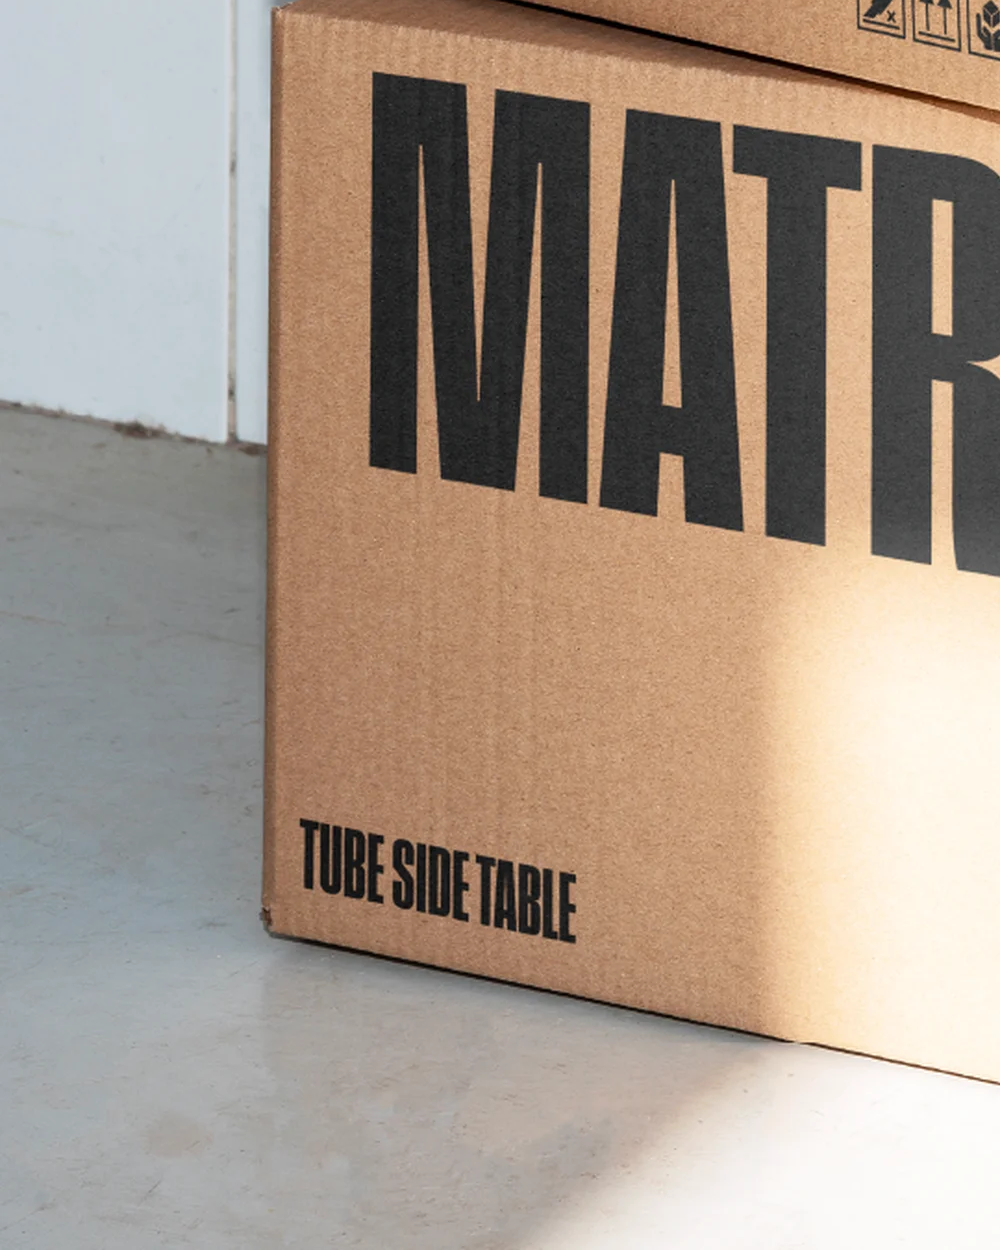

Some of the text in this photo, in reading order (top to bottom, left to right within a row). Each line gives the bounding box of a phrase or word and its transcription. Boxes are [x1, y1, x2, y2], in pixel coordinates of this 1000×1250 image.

[299, 818, 577, 944] TUBE SIDE TABLE
